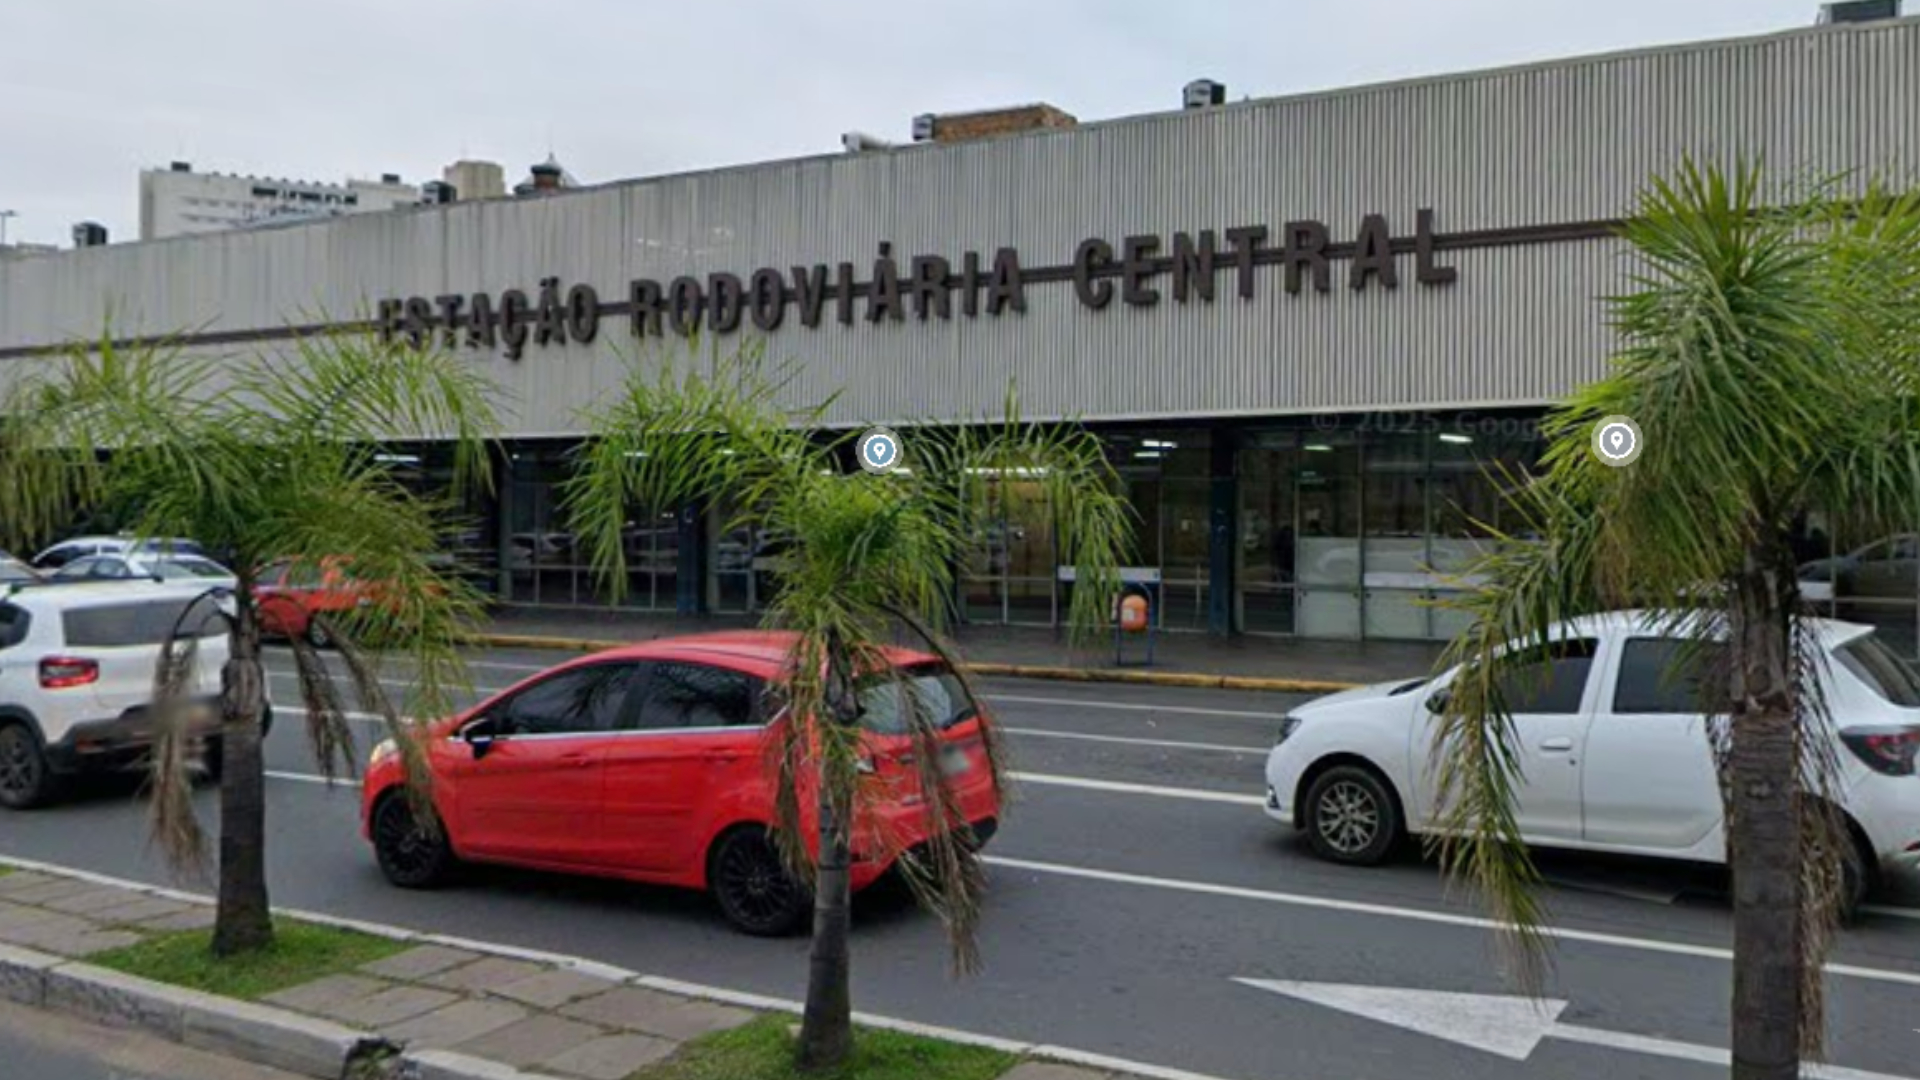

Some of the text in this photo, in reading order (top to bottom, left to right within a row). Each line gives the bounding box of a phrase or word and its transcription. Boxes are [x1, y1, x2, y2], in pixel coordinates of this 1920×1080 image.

[379, 207, 1457, 361] ESTAÇÃO RODOVIÁRIA CENTRAL
